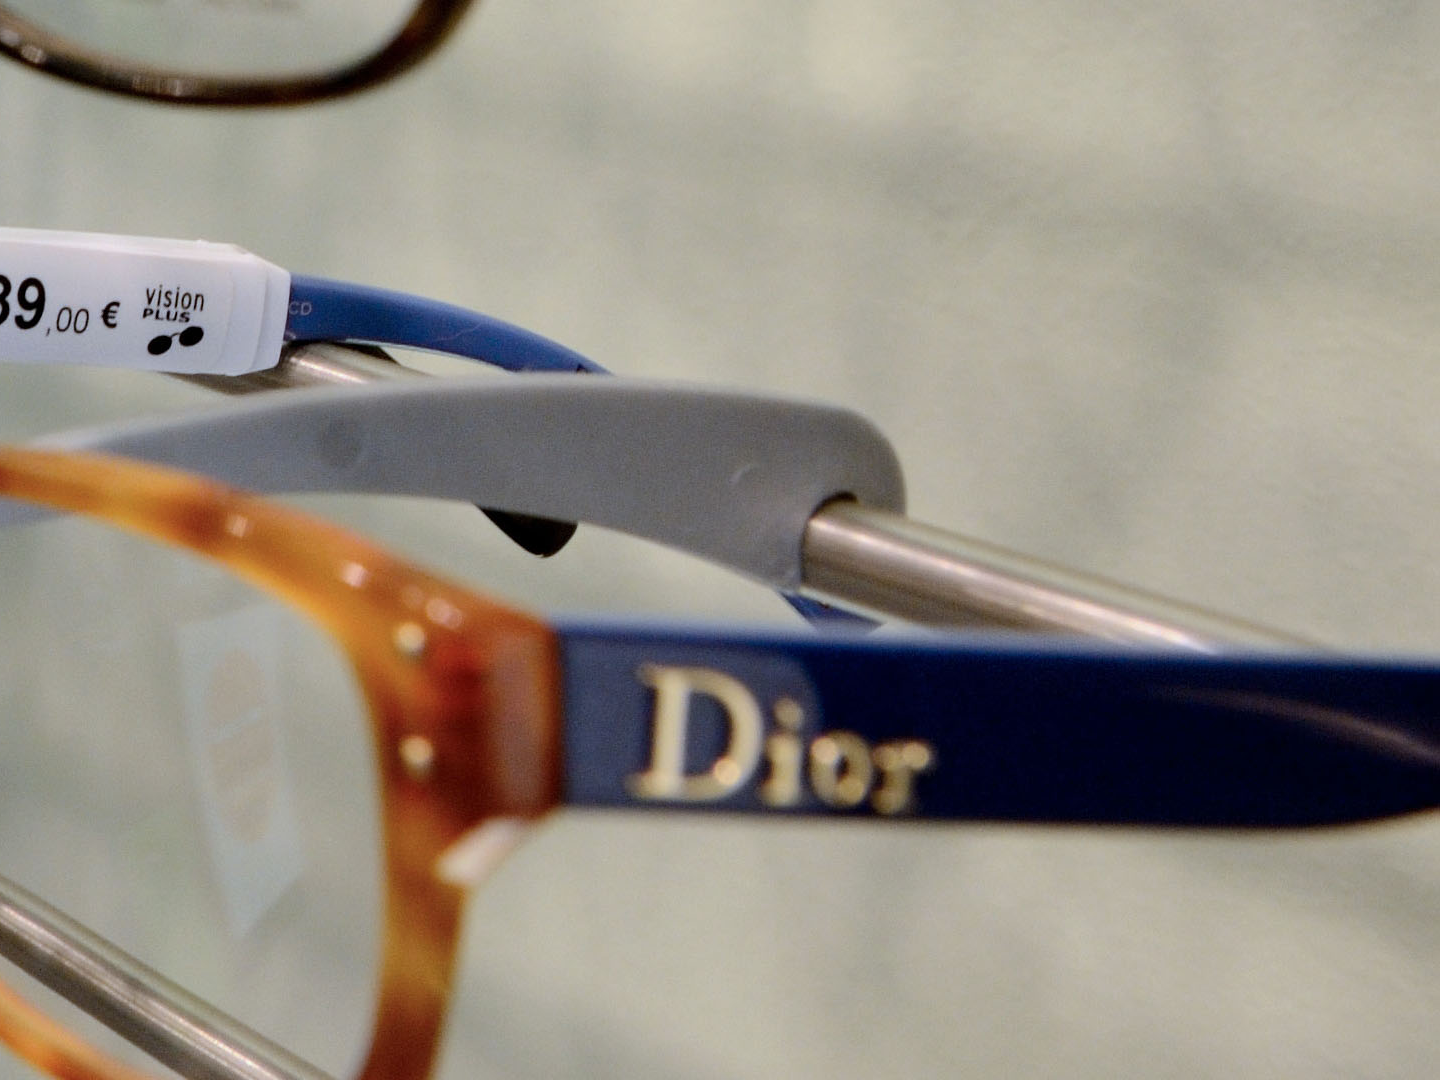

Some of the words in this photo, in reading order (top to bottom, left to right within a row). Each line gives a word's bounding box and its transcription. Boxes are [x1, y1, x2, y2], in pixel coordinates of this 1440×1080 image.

[145, 284, 205, 311] vision
[100, 300, 121, 329] €
[142, 308, 191, 324] PLUS
[624, 662, 937, 814] Dior
